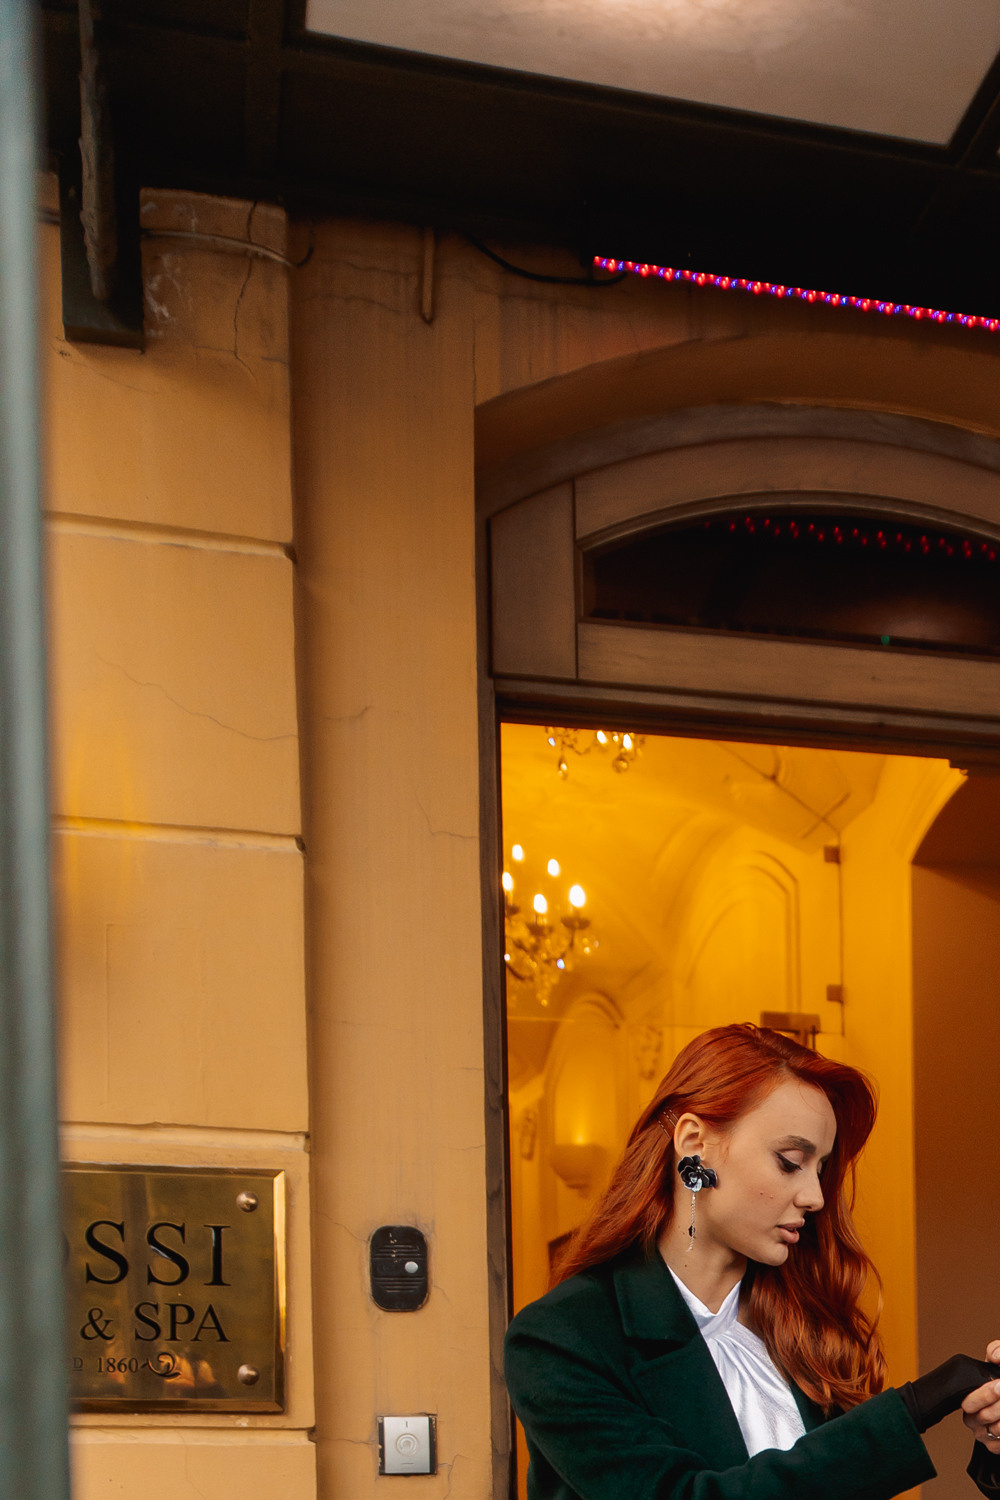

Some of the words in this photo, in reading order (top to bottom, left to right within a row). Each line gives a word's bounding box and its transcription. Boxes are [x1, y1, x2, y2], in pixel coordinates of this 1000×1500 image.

[62, 1220, 232, 1287] SSI
[80, 1307, 115, 1341] &
[134, 1301, 232, 1343] SPA
[97, 1357, 139, 1374] 1860
